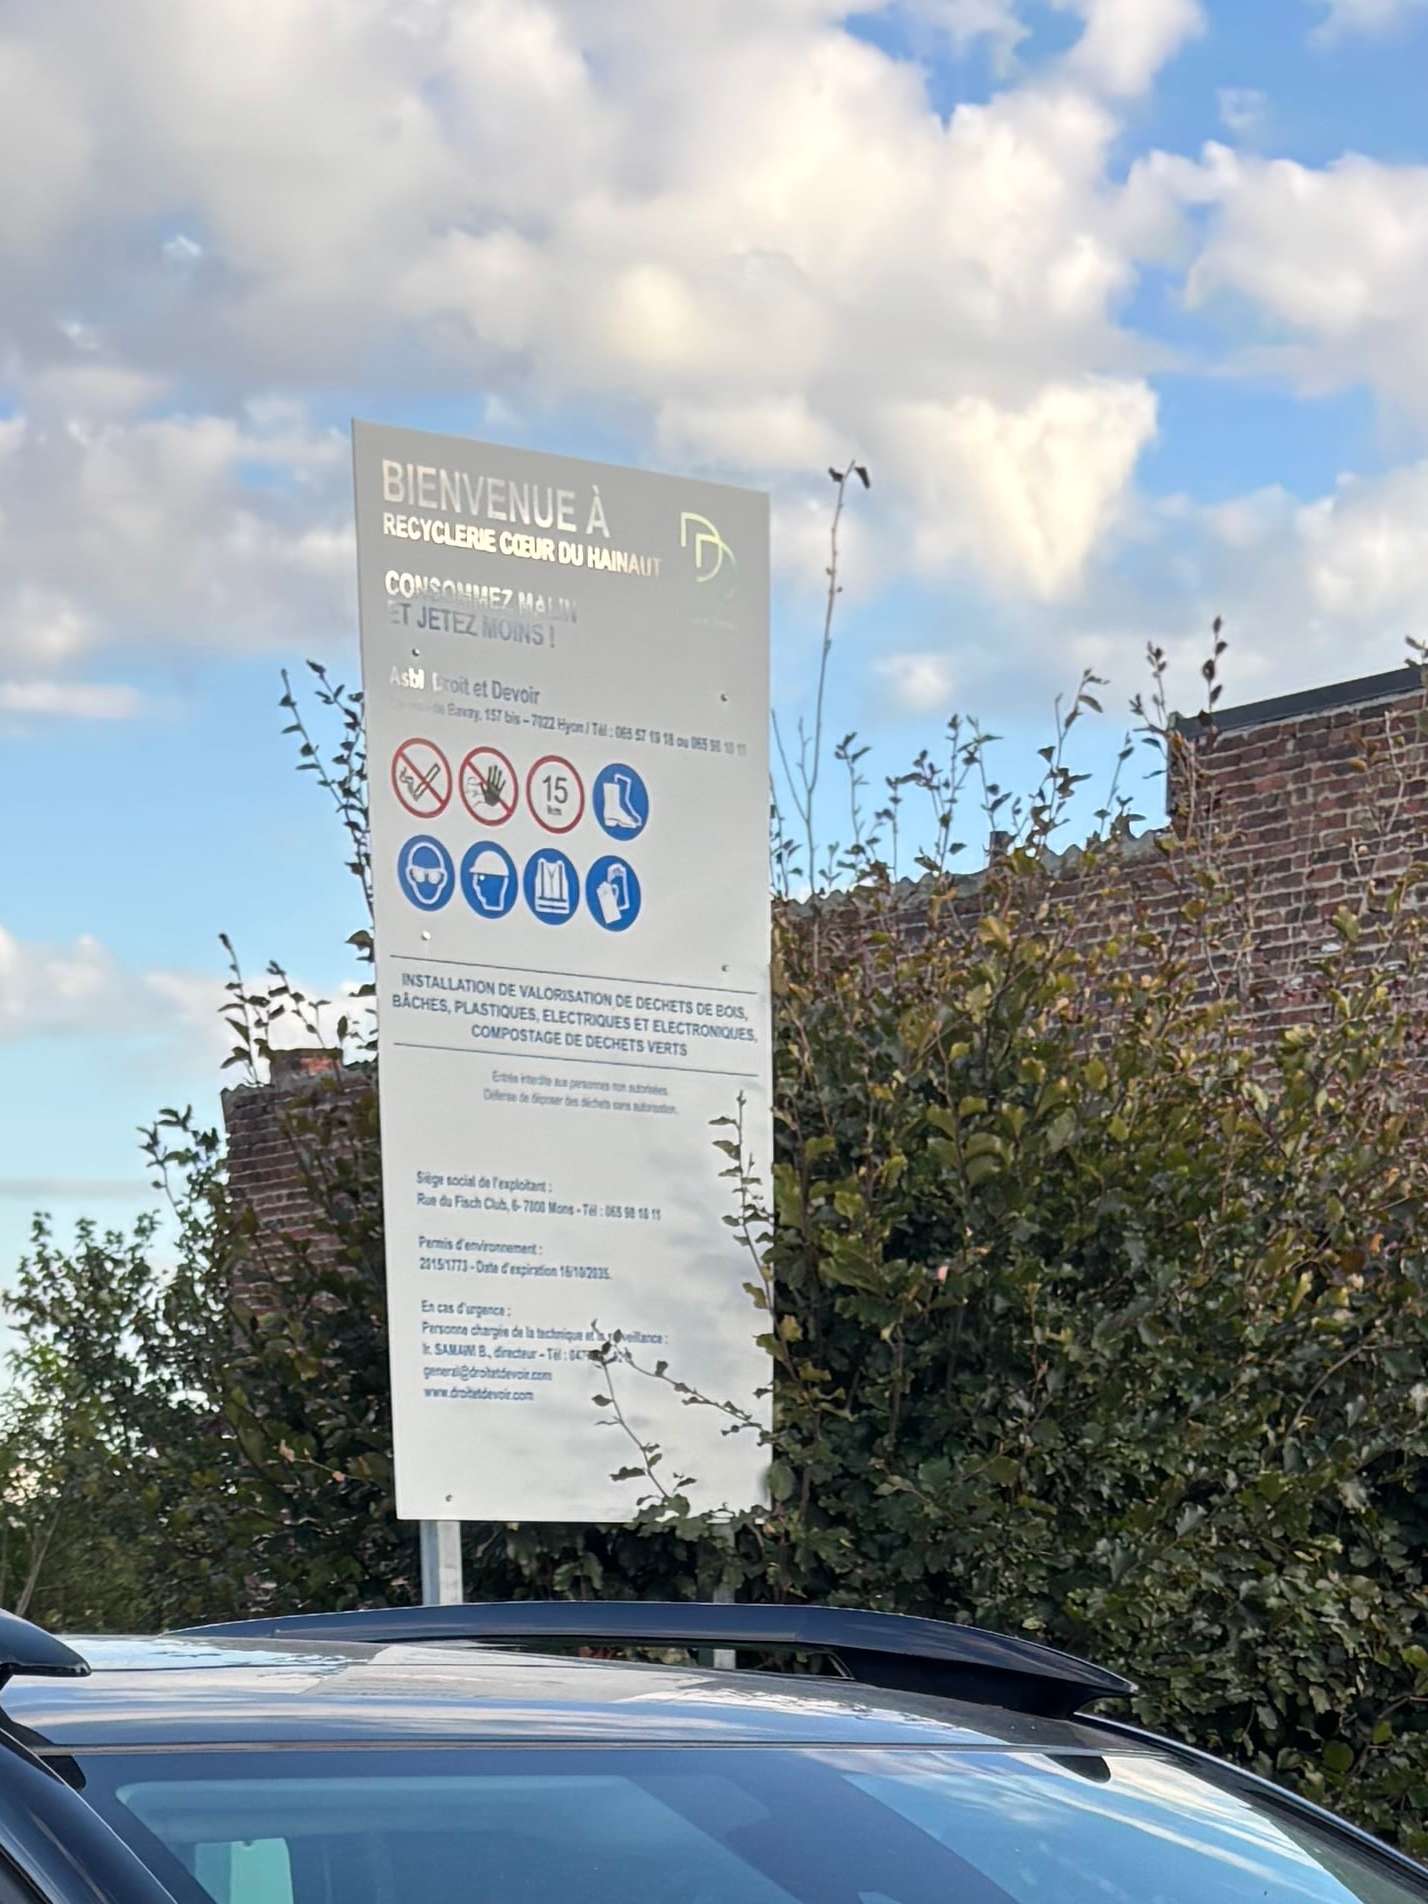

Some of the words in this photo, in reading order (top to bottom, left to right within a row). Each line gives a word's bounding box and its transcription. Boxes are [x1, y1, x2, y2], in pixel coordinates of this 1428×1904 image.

[382, 459, 577, 533] BIENVENUE
[586, 484, 611, 538] À
[383, 512, 497, 553] RECYCLERIE
[499, 531, 555, 562] CŒUR
[558, 541, 583, 567] DU
[587, 546, 663, 577] HAINAUT
[385, 570, 513, 609] CONSOMMEZ
[416, 606, 478, 637] JETEZ
[482, 616, 545, 646] MOINS
[389, 666, 425, 689] Asbl
[432, 672, 470, 696] Droit
[473, 680, 488, 698] et
[491, 680, 540, 704] Devoir
[542, 775, 568, 803] 15
[402, 972, 495, 995] INSTALLATION
[498, 983, 516, 997] DE
[519, 985, 612, 1007] VALORISATION
[615, 994, 633, 1009] DE
[636, 996, 693, 1015] DECHETS
[697, 1002, 713, 1017] DE
[716, 1004, 748, 1022] BOIS,
[392, 992, 451, 1015] BÂCHES,
[454, 1000, 540, 1023] PLASTIQUES,
[543, 1010, 631, 1030] ELECTRIQUES
[634, 1017, 650, 1032] ET
[653, 1019, 758, 1043] ELECTRONIQUES,
[471, 1024, 562, 1045] COMPOSTAGE
[565, 1032, 582, 1047] DE
[585, 1034, 644, 1052] DECHETS
[647, 1039, 688, 1057] VERTS
[417, 1171, 444, 1188] Siège
[447, 1174, 476, 1187] social
[478, 1176, 491, 1189] de
[417, 1192, 437, 1206] Rue
[439, 1194, 453, 1208] du
[548, 1201, 574, 1216] Mons
[418, 1235, 453, 1250] Permis
[476, 1260, 498, 1274] Date
[421, 1299, 435, 1313] En
[437, 1303, 454, 1314] cas
[421, 1321, 468, 1336] Personne
[512, 1325, 523, 1338] de
[525, 1326, 535, 1339] la
[536, 1328, 583, 1343] technique
[494, 1345, 538, 1360] directeur
